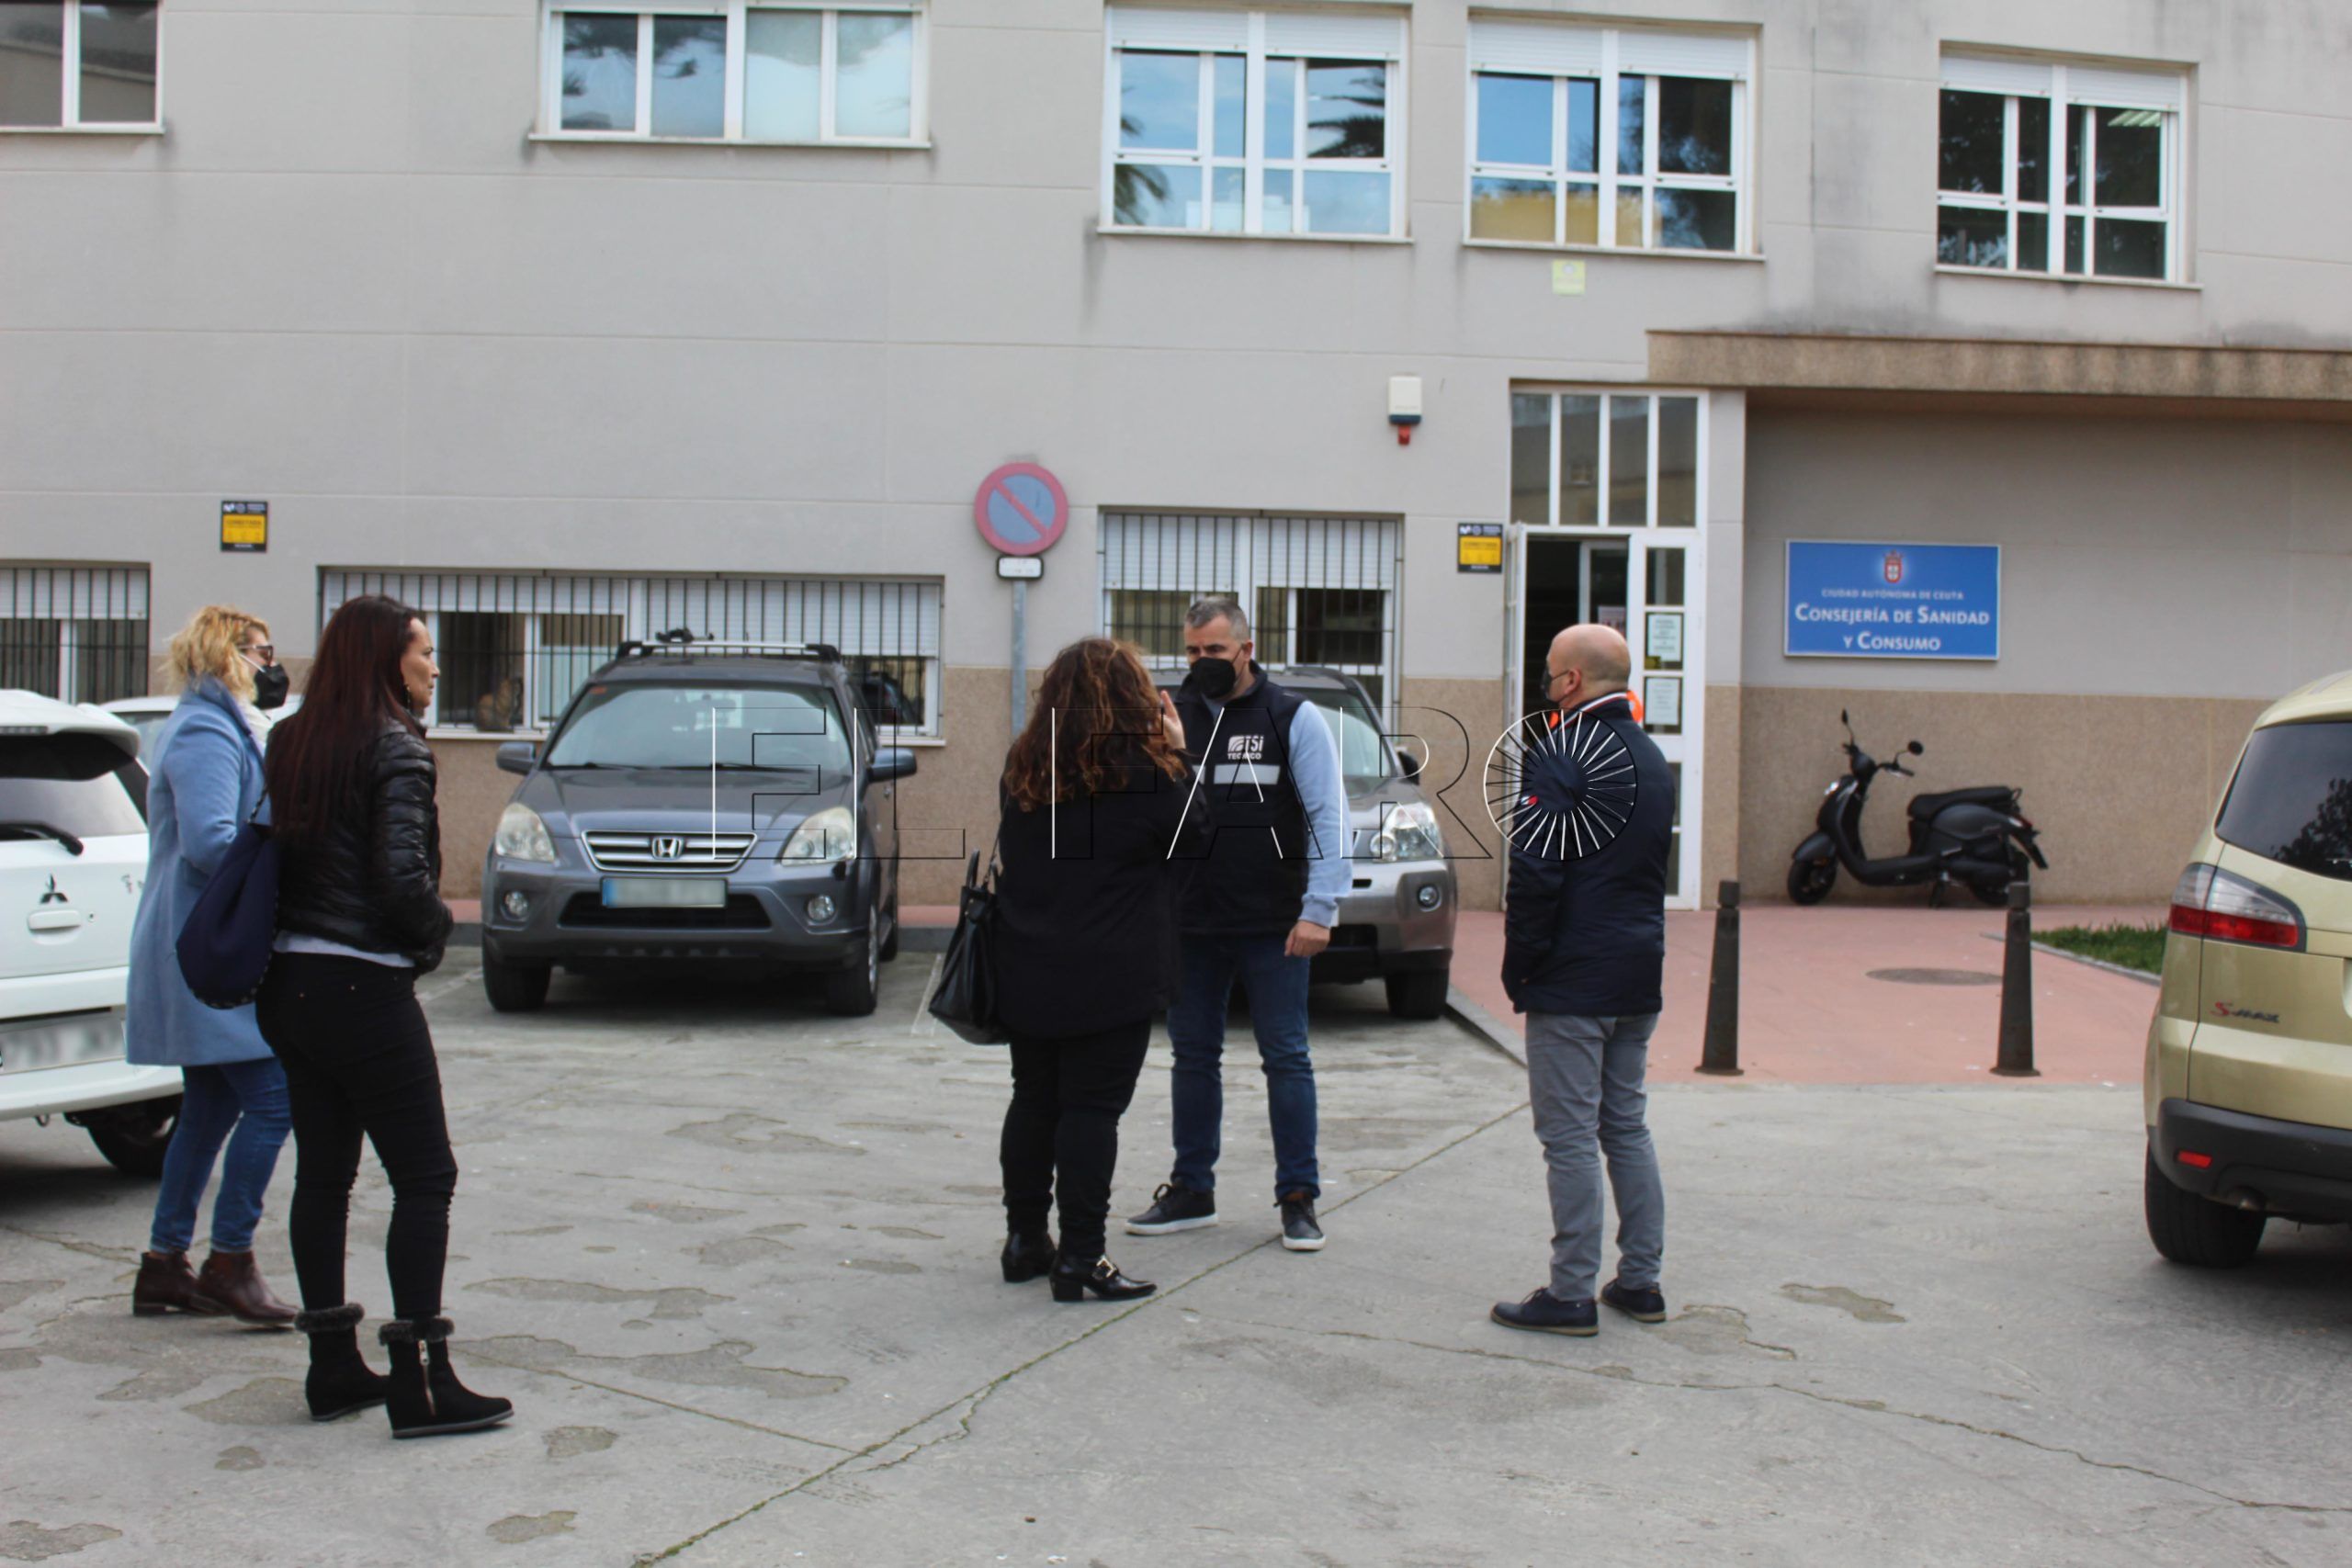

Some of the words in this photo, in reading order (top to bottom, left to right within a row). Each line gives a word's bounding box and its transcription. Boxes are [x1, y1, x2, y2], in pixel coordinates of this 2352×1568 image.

[1919, 592, 1931, 600] DE
[1894, 610, 1913, 624] DE
[1917, 605, 1990, 626] SANIDAD
[1858, 631, 1941, 651] CONSUMO
